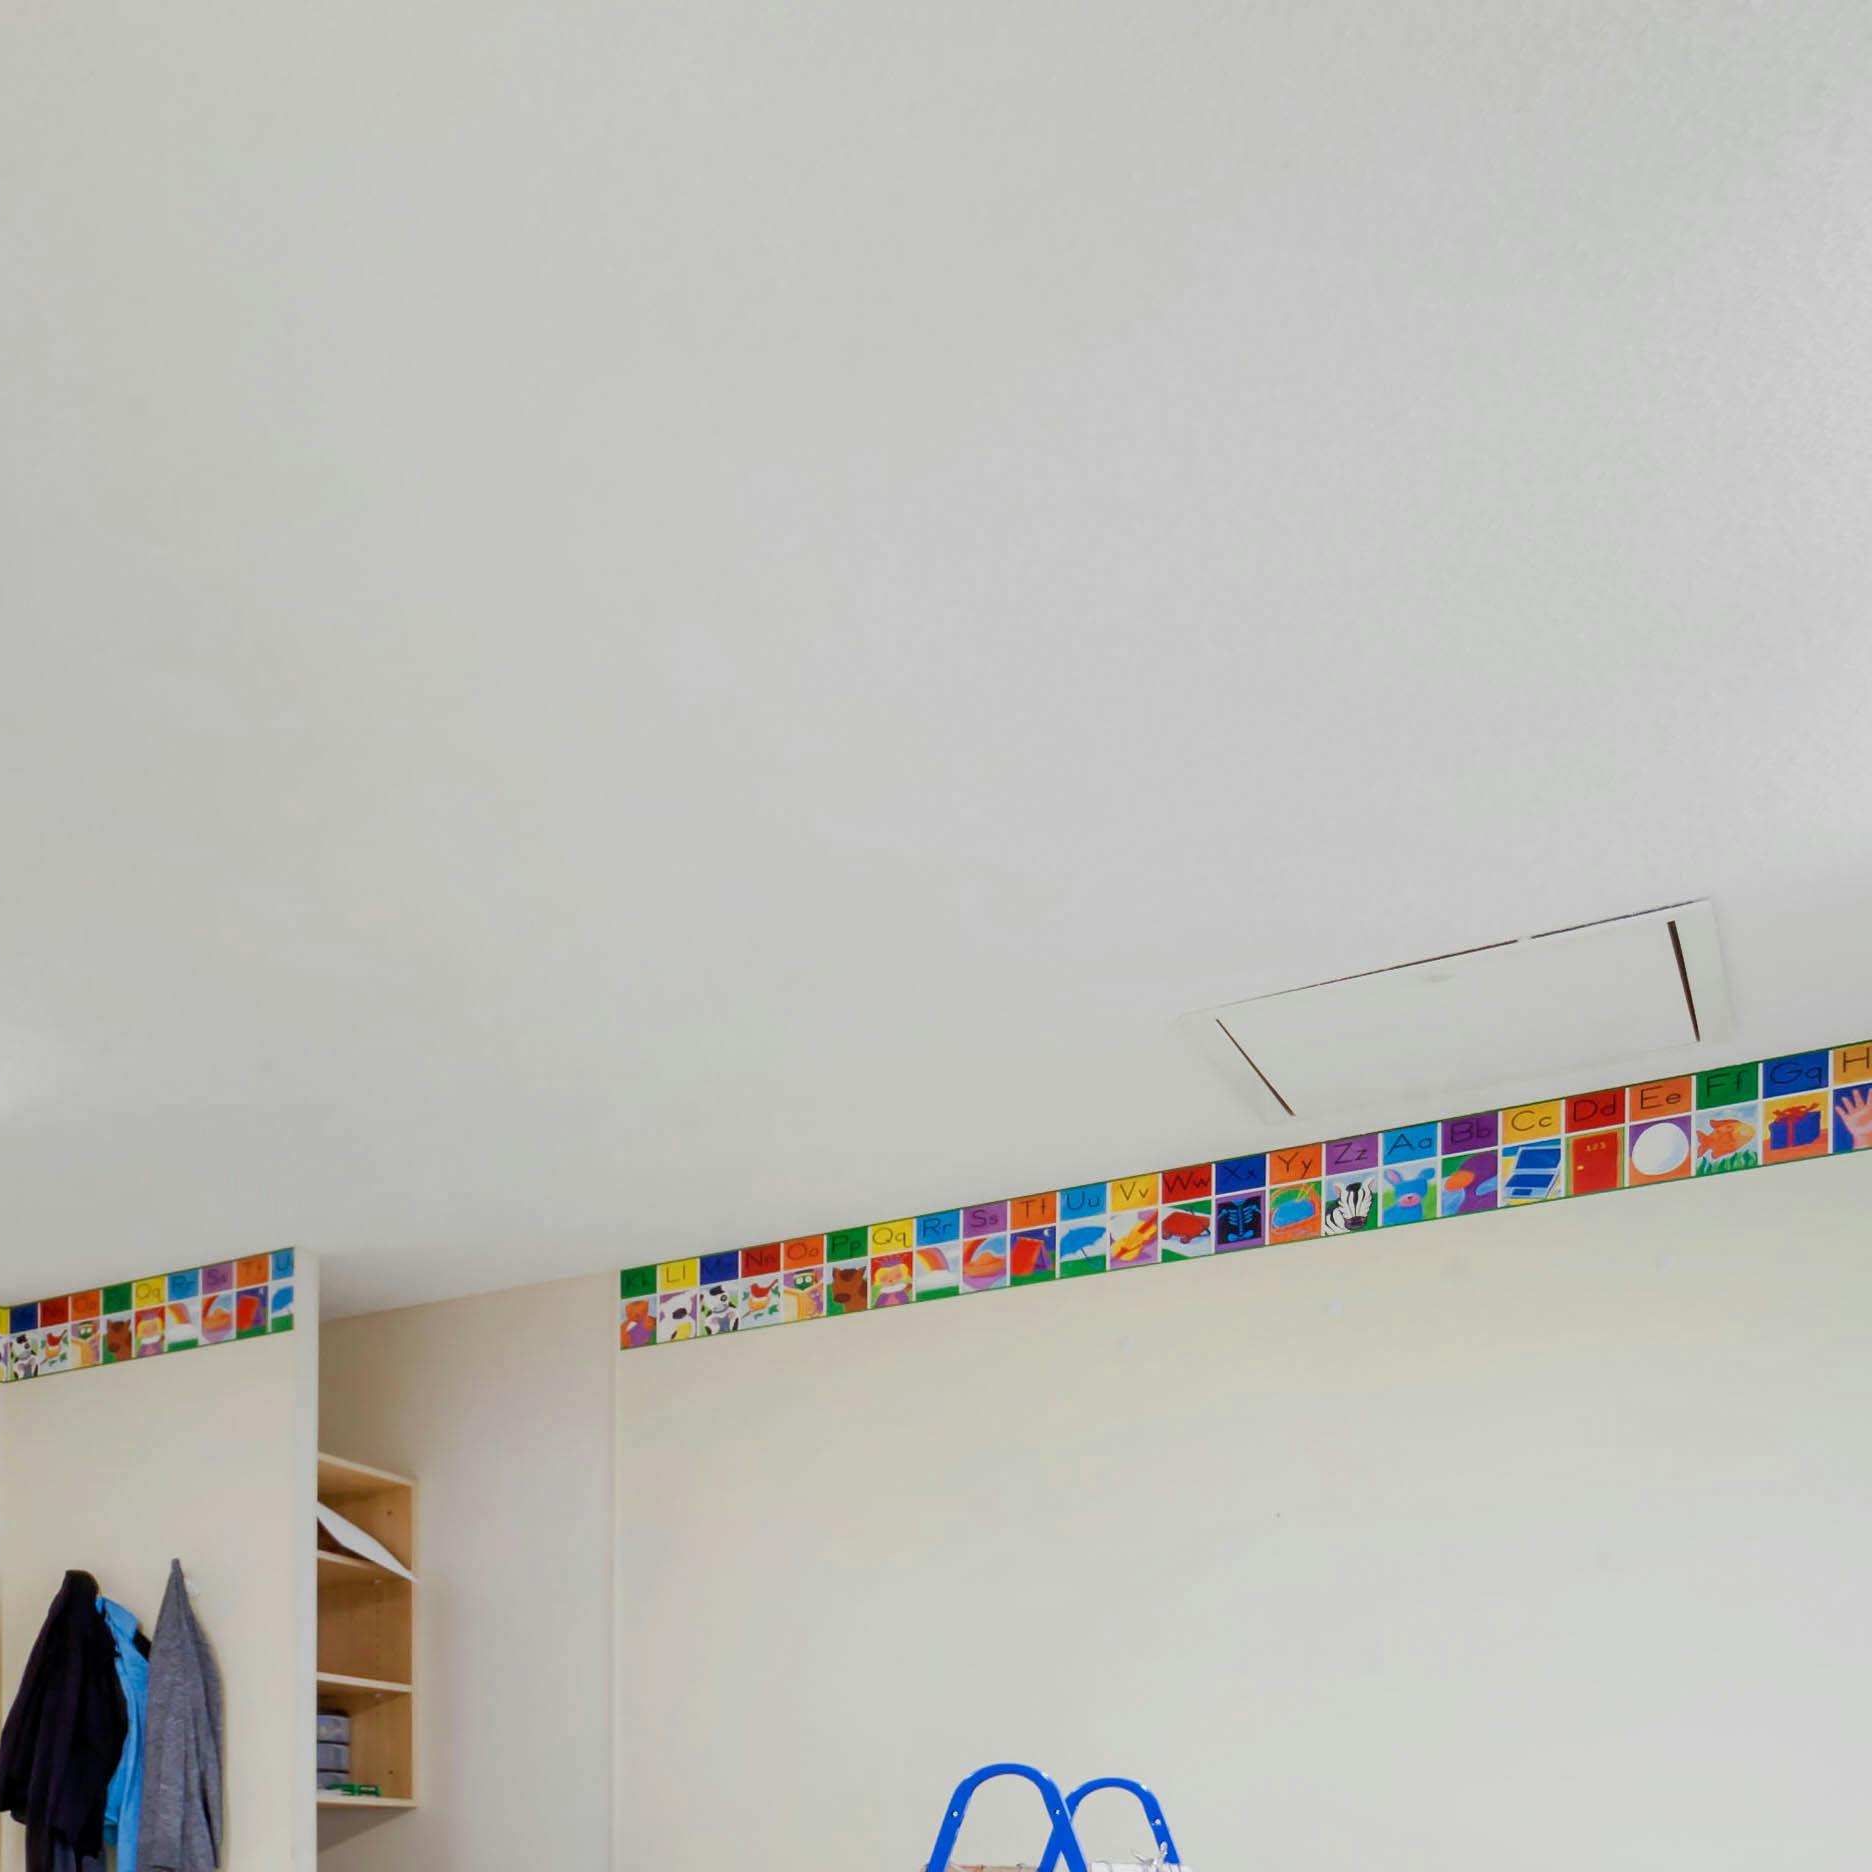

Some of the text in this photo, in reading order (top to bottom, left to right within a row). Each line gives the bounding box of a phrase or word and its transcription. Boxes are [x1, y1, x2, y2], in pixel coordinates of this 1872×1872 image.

[666, 1264, 686, 1284] Ll
[787, 1243, 819, 1261] Oo
[831, 1234, 862, 1254] Pp
[871, 1226, 912, 1249] Qq
[922, 1217, 953, 1237] Rr
[969, 1209, 999, 1229] Ss
[1019, 1198, 1048, 1218] Tt
[1066, 1190, 1101, 1211] Uu
[1119, 1181, 1149, 1202] Vv
[1162, 1171, 1210, 1194] Ww
[1222, 1163, 1255, 1181] Xx
[1277, 1152, 1313, 1180] Yy
[1333, 1142, 1368, 1165] Zz
[1387, 1133, 1432, 1156] Aa
[1450, 1119, 1491, 1144] Bb
[1511, 1110, 1553, 1132] Cc
[1573, 1094, 1617, 1122] Dd
[1640, 1086, 1681, 1110] Ee
[1706, 1068, 1749, 1097] Ff
[1770, 1061, 1824, 1088] Gg
[1841, 1047, 1870, 1073] H
